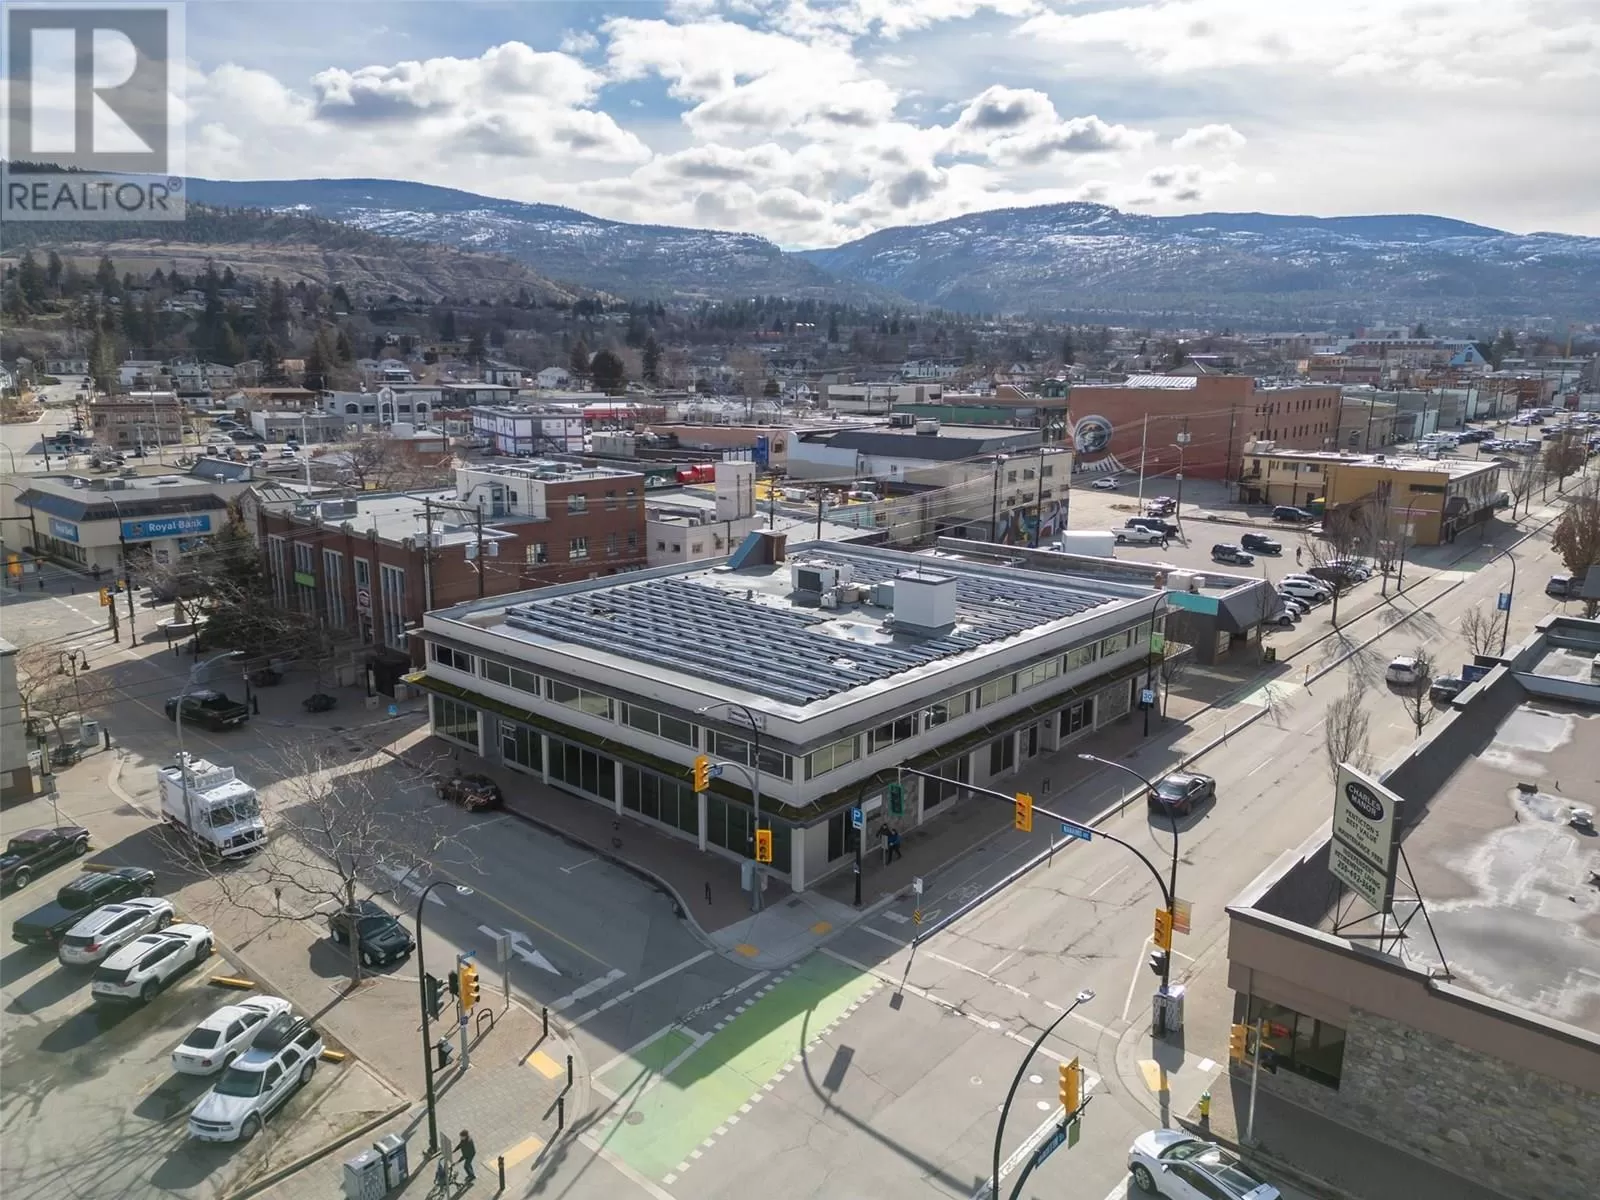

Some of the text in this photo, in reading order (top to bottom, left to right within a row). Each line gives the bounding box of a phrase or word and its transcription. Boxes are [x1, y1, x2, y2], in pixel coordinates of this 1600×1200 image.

[149, 519, 203, 533] Royal Bank
[1348, 784, 1382, 812] CHARLES
[1351, 793, 1377, 817] MANOR
[853, 809, 861, 821] P
[1345, 816, 1377, 844] BEST VALUE
